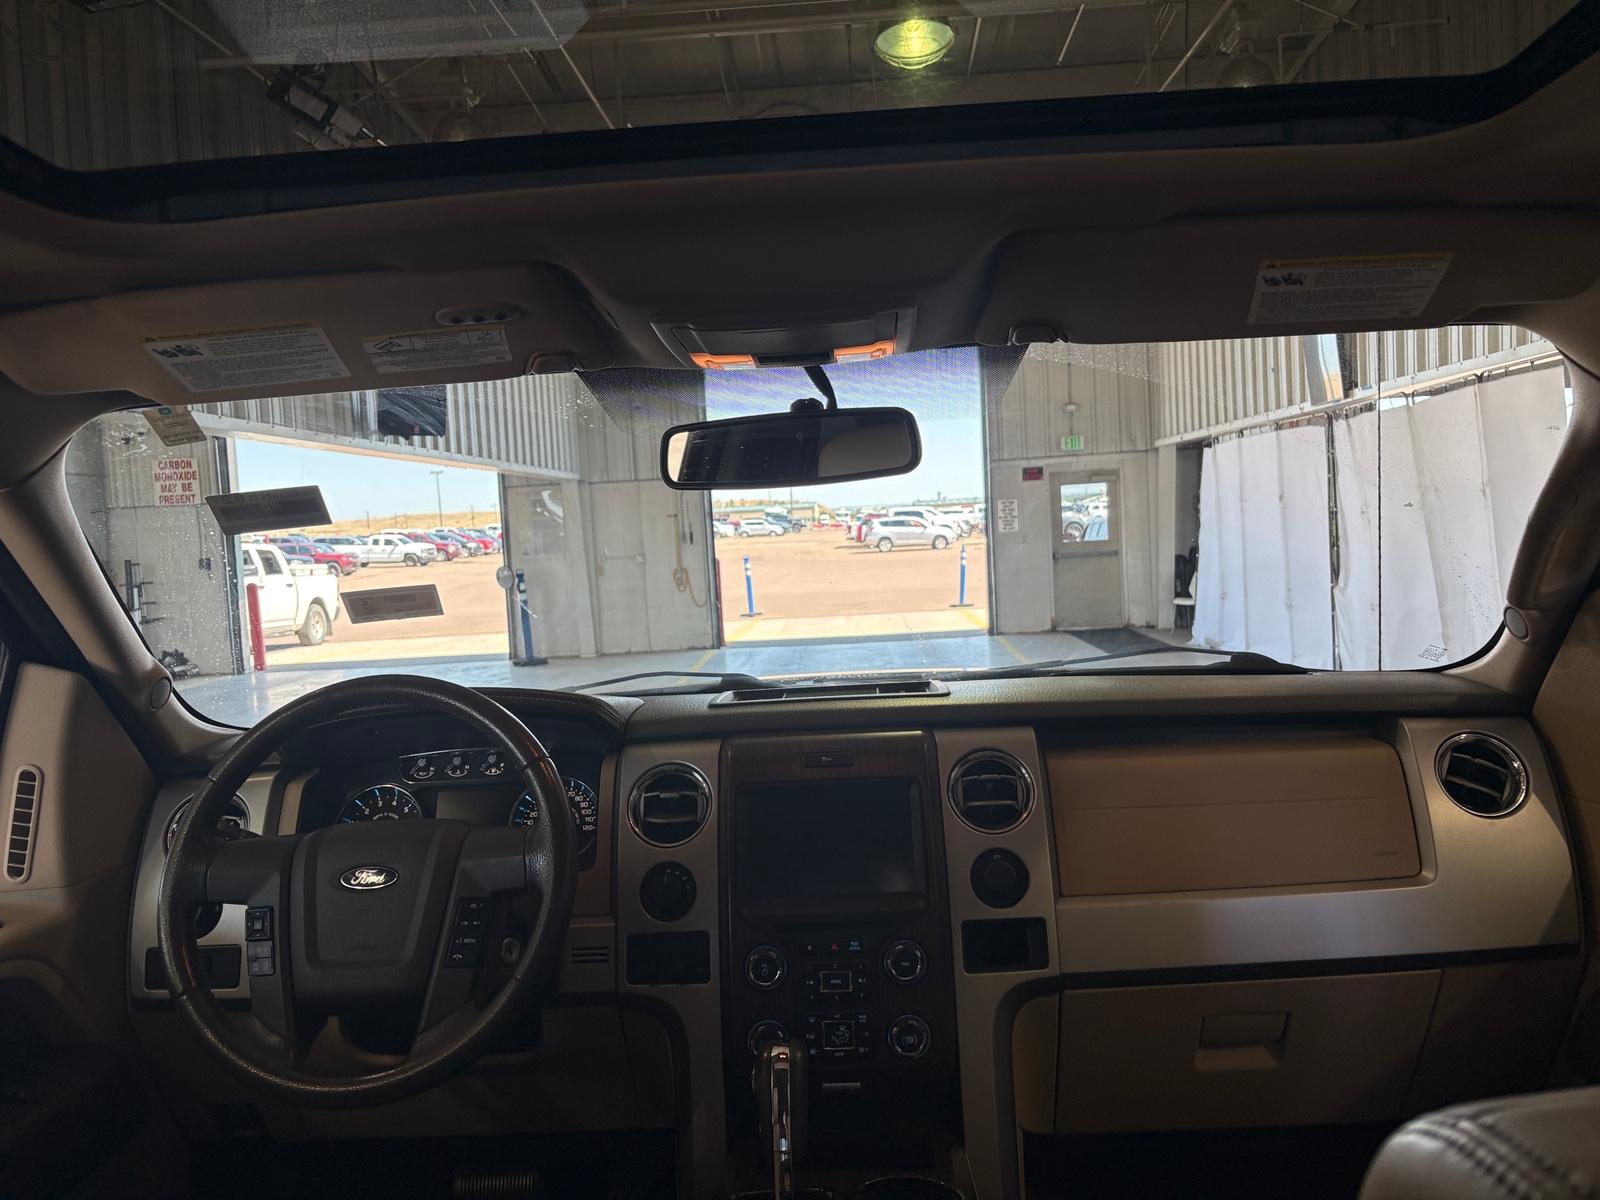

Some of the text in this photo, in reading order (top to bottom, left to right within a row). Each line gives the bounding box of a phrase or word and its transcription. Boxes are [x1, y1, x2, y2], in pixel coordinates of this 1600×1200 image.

[1064, 435, 1081, 450] EXIT
[158, 459, 192, 470] CARBON
[154, 471, 198, 482] MONOXIDE
[160, 482, 193, 493] MAY BE
[159, 494, 196, 504] PRESENT
[350, 869, 387, 885] Ford
